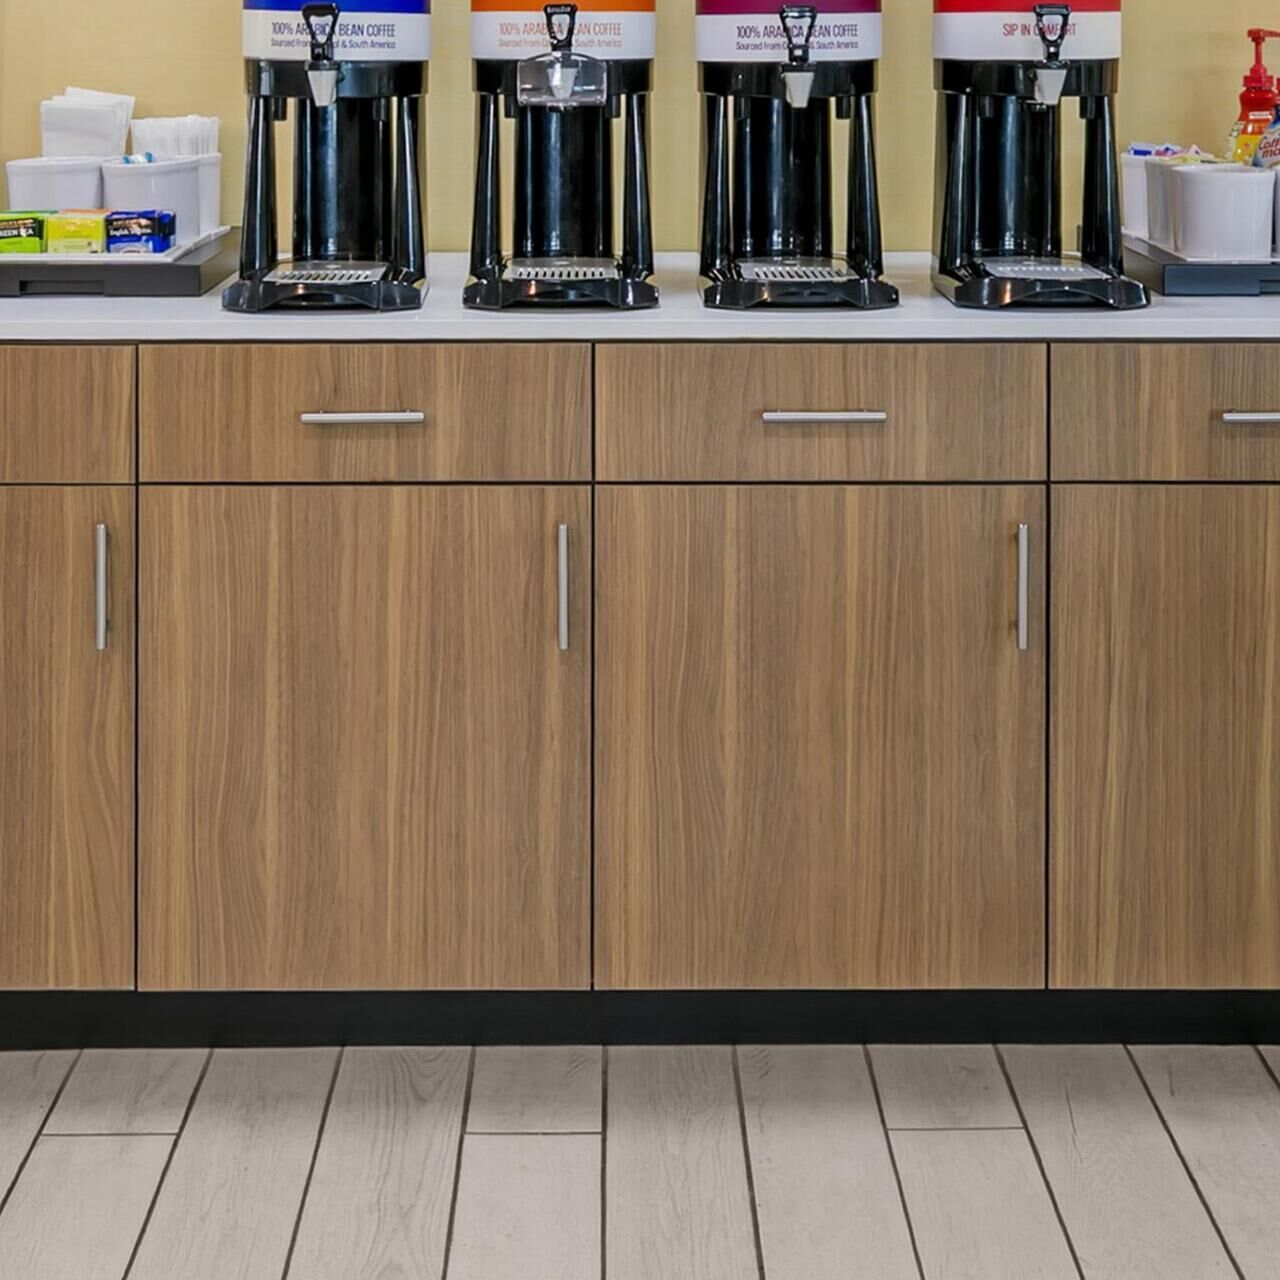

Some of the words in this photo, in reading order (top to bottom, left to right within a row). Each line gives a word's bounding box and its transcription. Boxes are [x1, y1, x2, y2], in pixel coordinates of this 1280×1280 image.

[271, 22, 293, 35] 100%
[339, 23, 364, 37] BEAN
[366, 23, 396, 37] COFFEE
[499, 22, 521, 36] 100%
[593, 22, 622, 36] COFFEE
[736, 26, 761, 39] 100%
[832, 24, 858, 37] COFFEE
[1002, 23, 1018, 37] SIP
[1020, 23, 1031, 36] IN
[348, 40, 370, 49] South
[736, 42, 762, 50] Sourced
